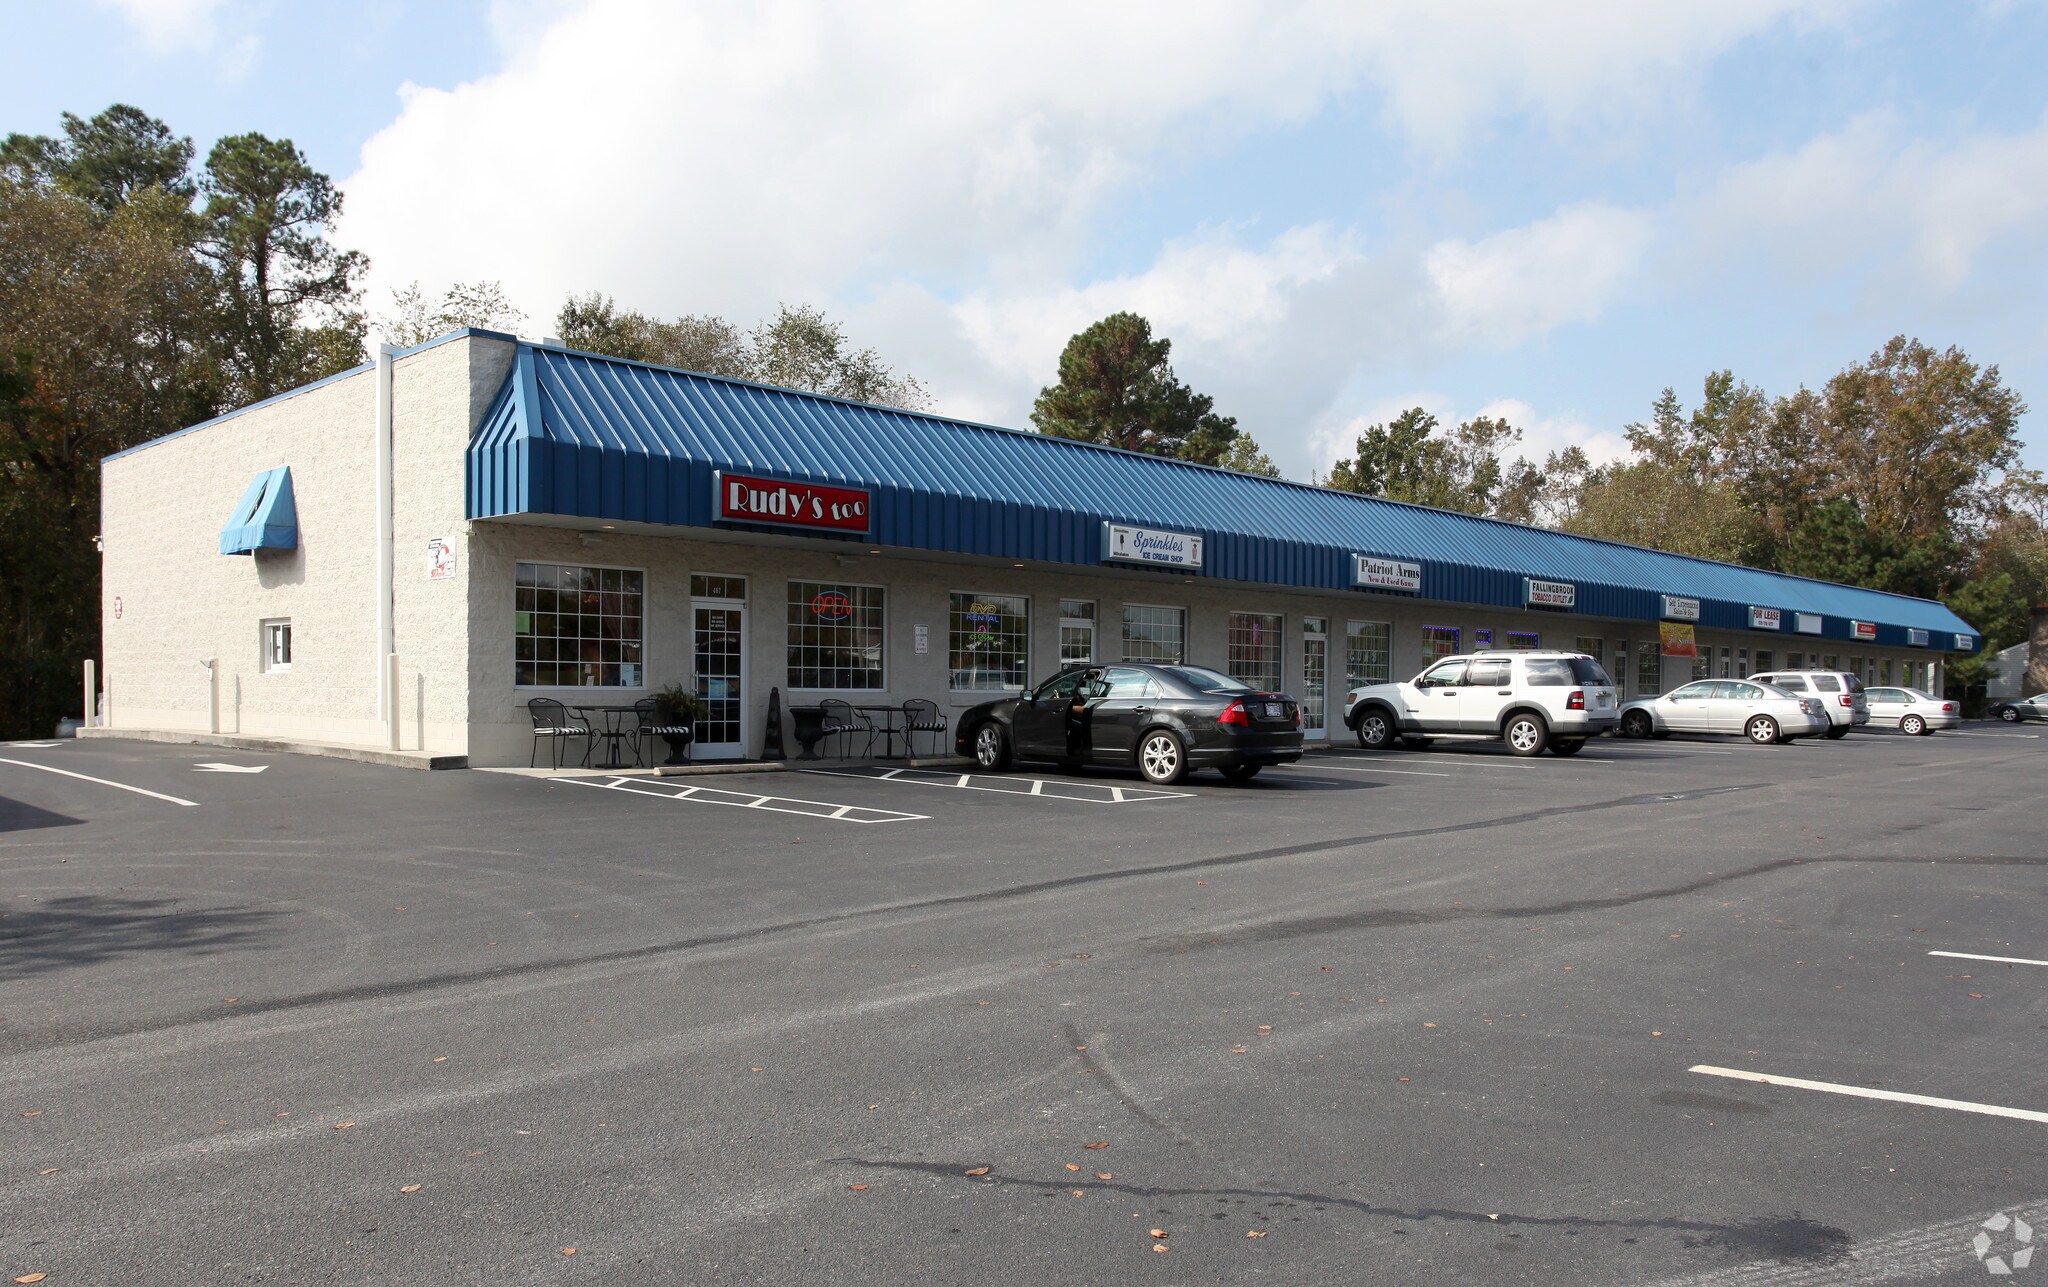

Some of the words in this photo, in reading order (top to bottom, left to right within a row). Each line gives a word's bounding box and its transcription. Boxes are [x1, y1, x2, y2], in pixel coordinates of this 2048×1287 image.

[730, 482, 823, 519] Rudy's
[831, 501, 865, 520] too
[1133, 531, 1183, 553] Sprinkles
[1142, 552, 1151, 560] ICE
[1152, 553, 1169, 561] CREAM
[1170, 555, 1183, 563] SHOP
[1361, 559, 1393, 575] Patriot
[1396, 564, 1419, 579] Arms
[1368, 574, 1379, 582] New
[1381, 576, 1385, 584] &
[1387, 576, 1399, 585] Used
[1400, 579, 1414, 587] Guns
[1532, 582, 1573, 595] FALLINGBROOK
[1532, 592, 1551, 603] TOBACCO
[1552, 594, 1568, 604] OUTLET
[811, 595, 852, 616] OPEN
[970, 603, 996, 614] DVD
[966, 613, 1000, 623] RENTAL
[1754, 609, 1762, 618] FOR
[1764, 609, 1779, 621] LEASE
